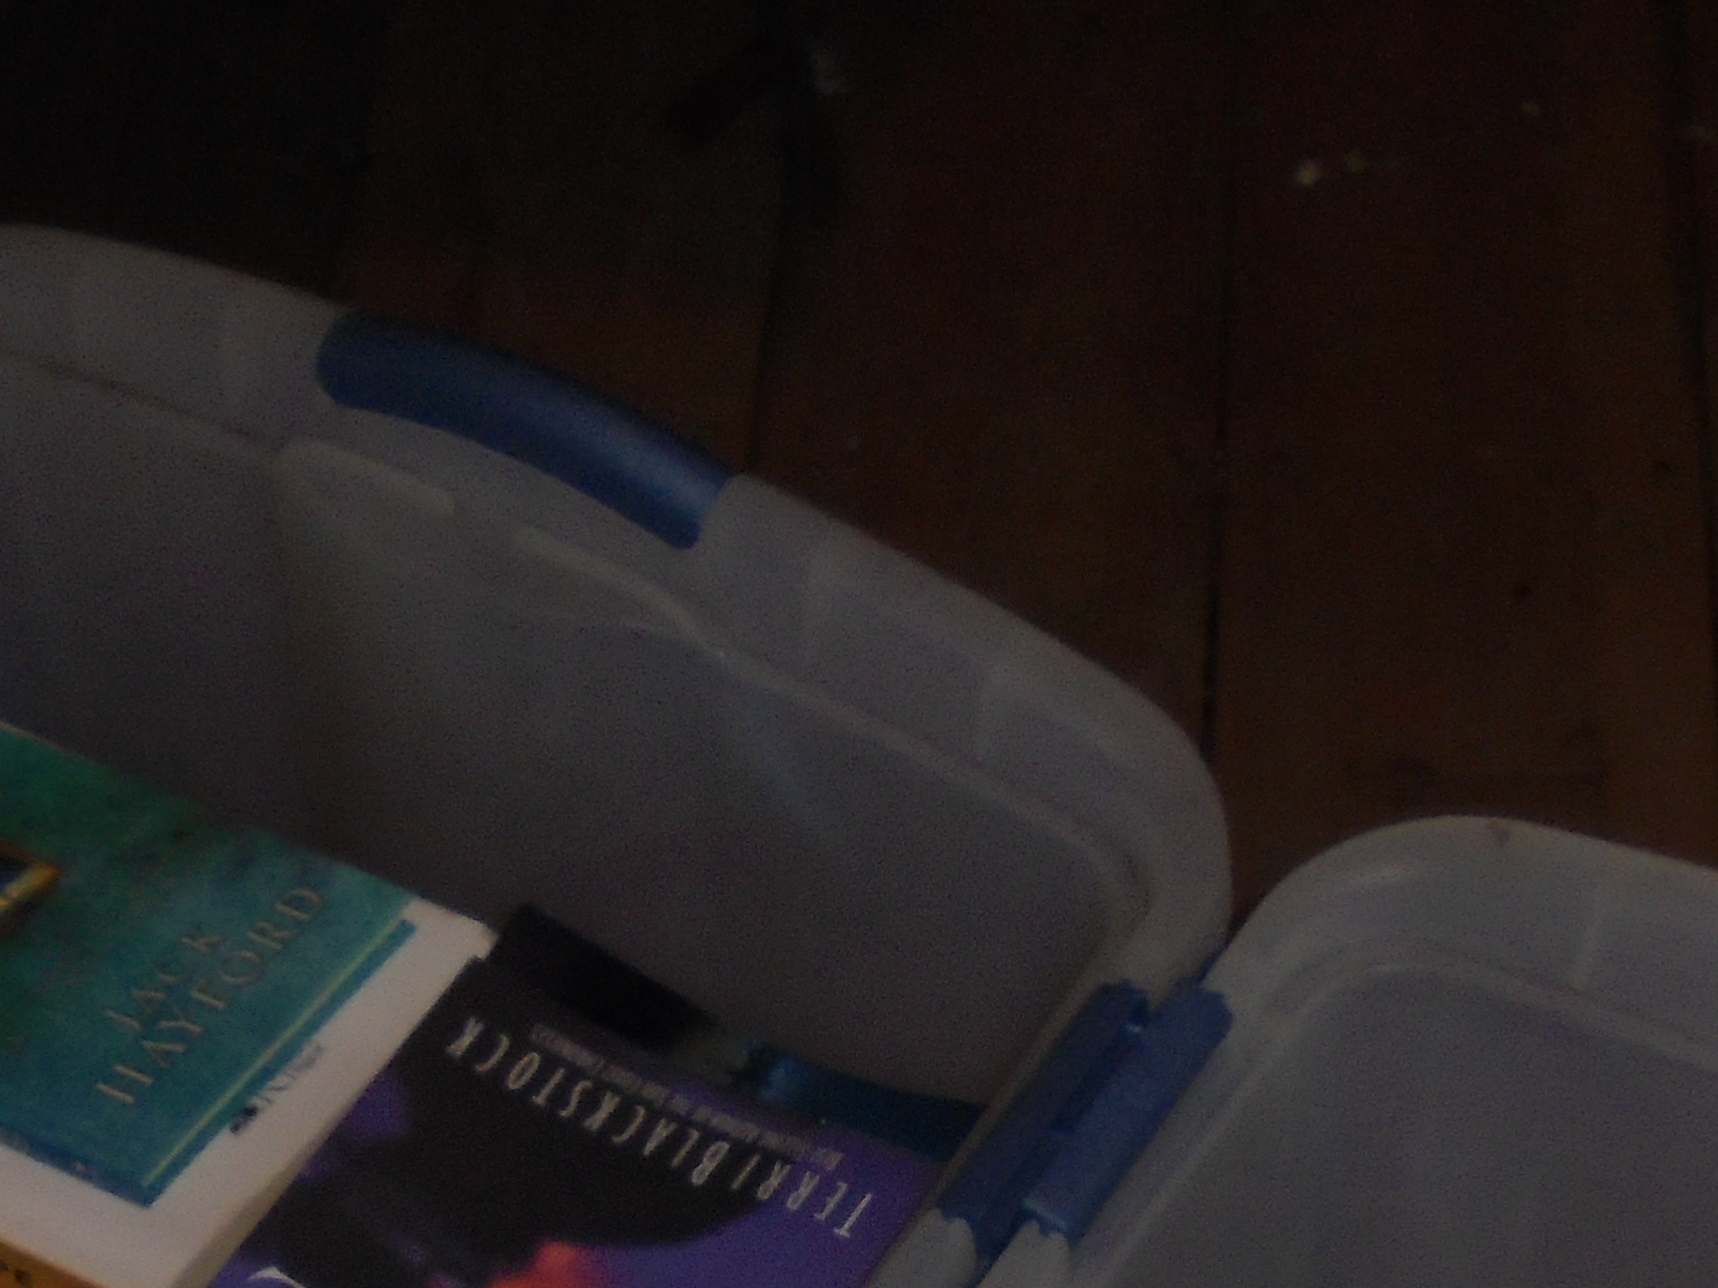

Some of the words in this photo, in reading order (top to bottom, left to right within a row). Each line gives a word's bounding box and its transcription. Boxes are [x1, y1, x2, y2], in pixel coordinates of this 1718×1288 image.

[94, 886, 327, 1107] HAYFORD
[104, 931, 225, 1034] JACK
[444, 1016, 732, 1187] BLACKSTOCK
[731, 1153, 874, 1238] TERRI
